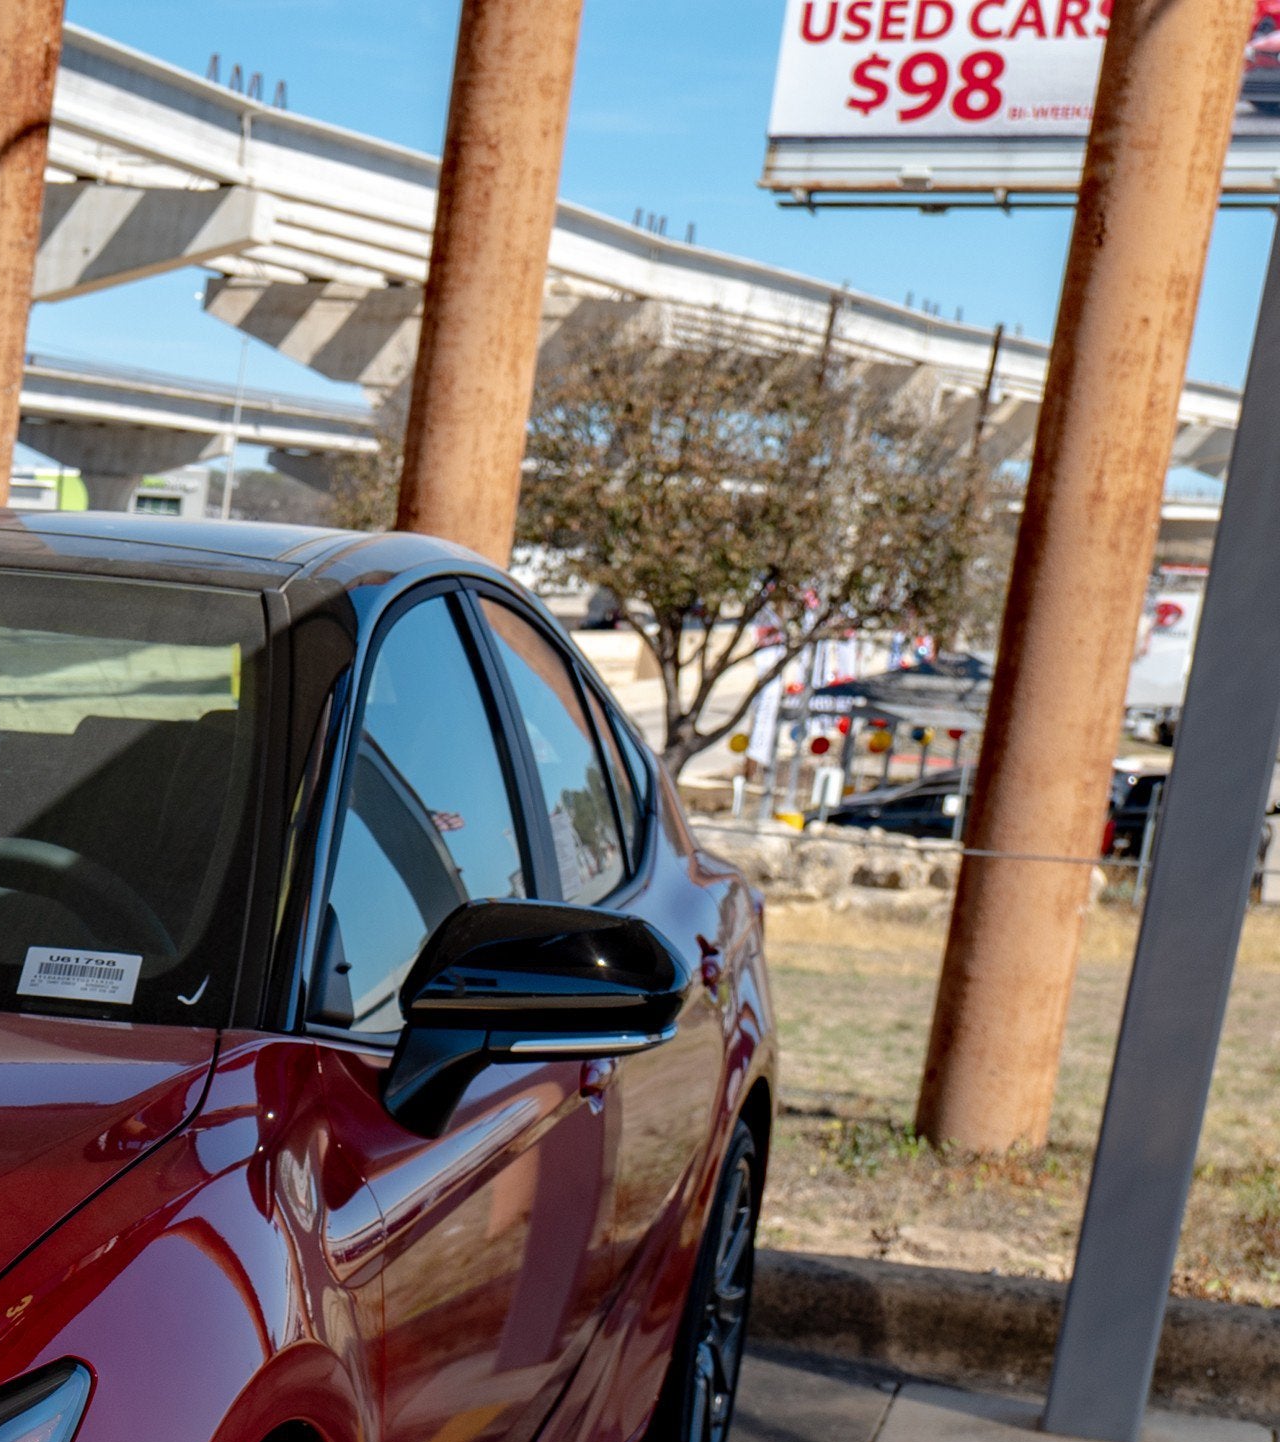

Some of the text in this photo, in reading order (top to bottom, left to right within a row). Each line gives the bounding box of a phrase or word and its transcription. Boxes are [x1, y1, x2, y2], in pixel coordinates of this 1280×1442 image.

[798, 0, 955, 43] USED
[845, 50, 1007, 123] $98
[1008, 105, 1094, 121] BI-WEEKL
[49, 955, 117, 967] U61798
